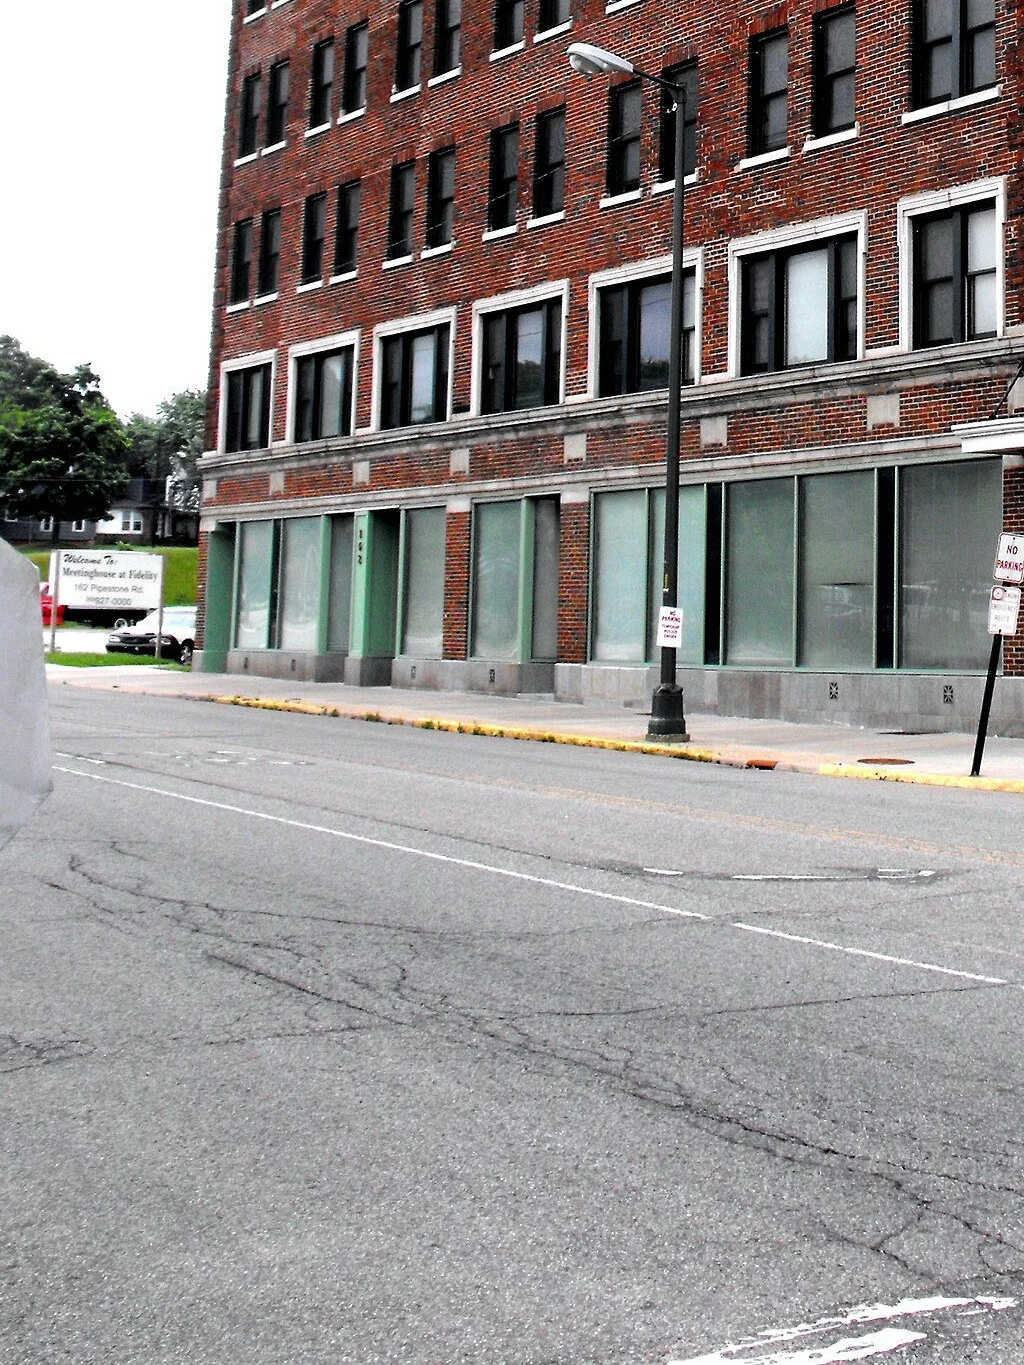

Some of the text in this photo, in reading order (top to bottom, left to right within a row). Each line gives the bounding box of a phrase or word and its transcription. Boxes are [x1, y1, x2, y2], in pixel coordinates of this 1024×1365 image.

[1006, 544, 1018, 554] NO
[63, 554, 102, 564] Welcome
[996, 560, 1023, 571] PARKING
[62, 567, 157, 582] Meetinghouse at Fidelity
[90, 584, 130, 593] Pipestone
